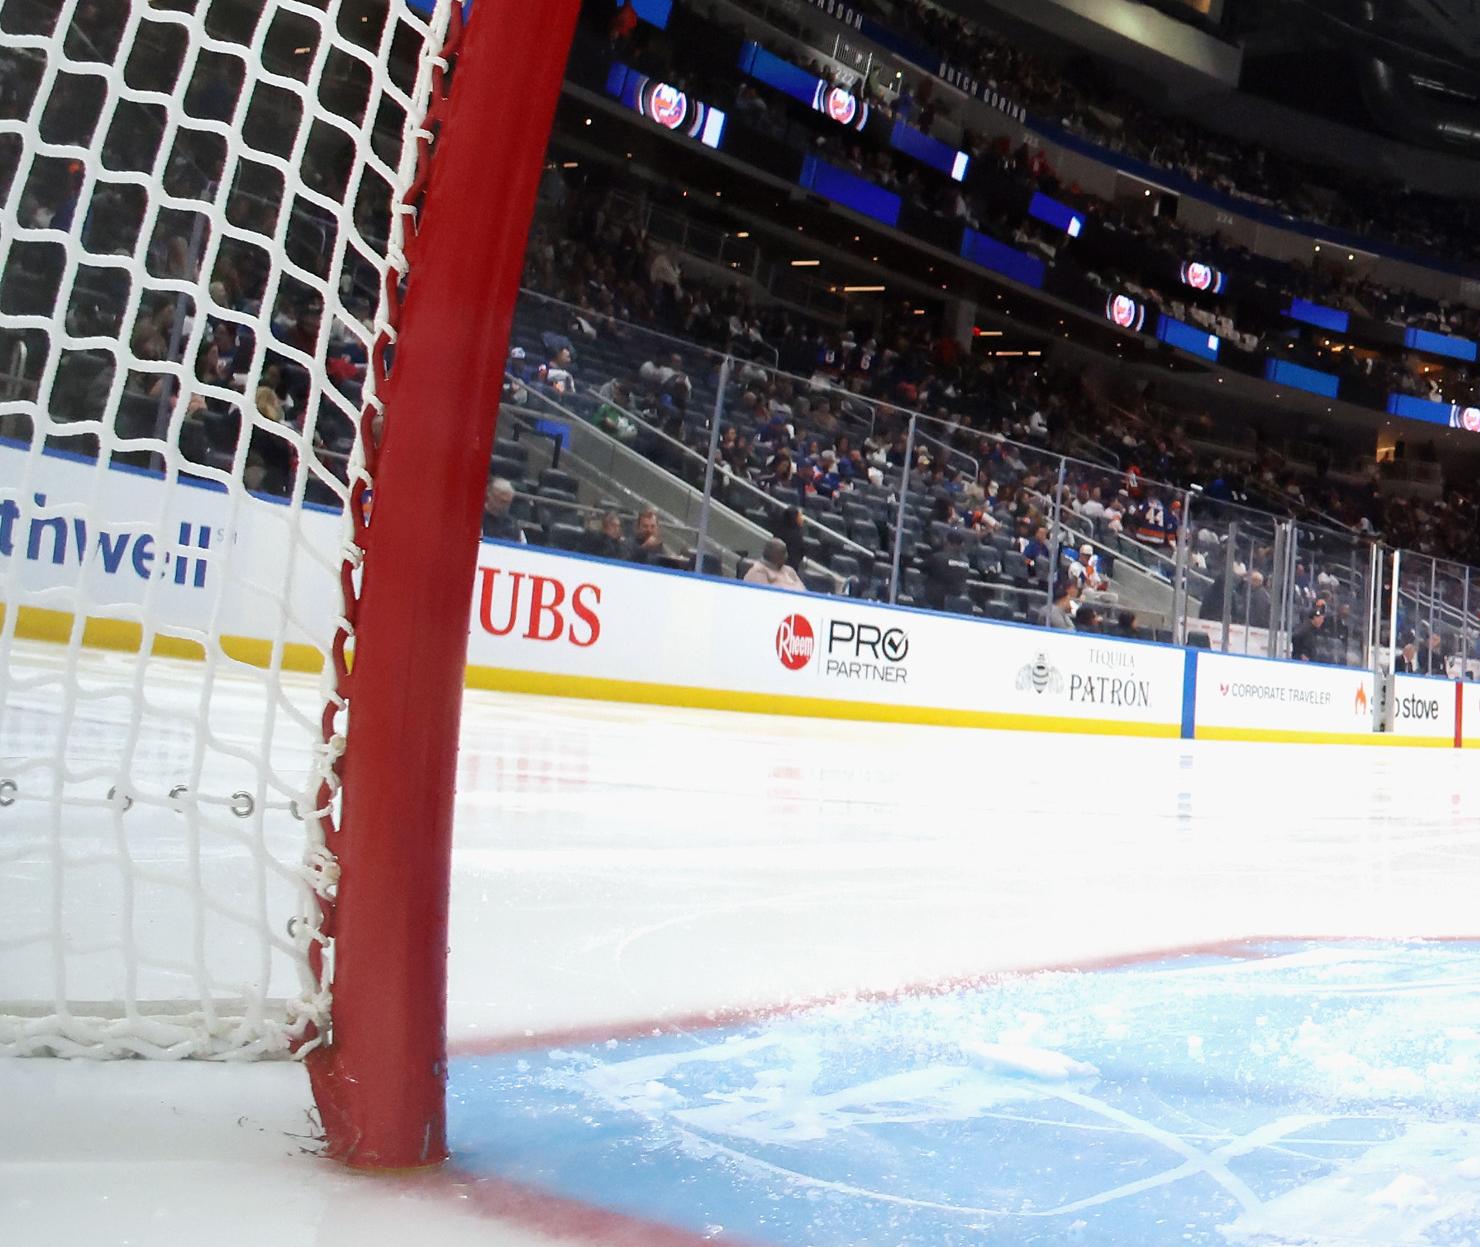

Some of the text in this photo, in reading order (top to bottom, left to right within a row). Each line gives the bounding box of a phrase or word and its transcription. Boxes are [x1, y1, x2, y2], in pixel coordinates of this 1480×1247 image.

[478, 566, 602, 648] UBS
[777, 615, 814, 664] Rheem
[1089, 648, 1136, 669] TEQUILA
[826, 660, 908, 684] PARTNER
[1231, 683, 1331, 705] CORPORATE TRAVELER
[1402, 693, 1439, 720] stove
